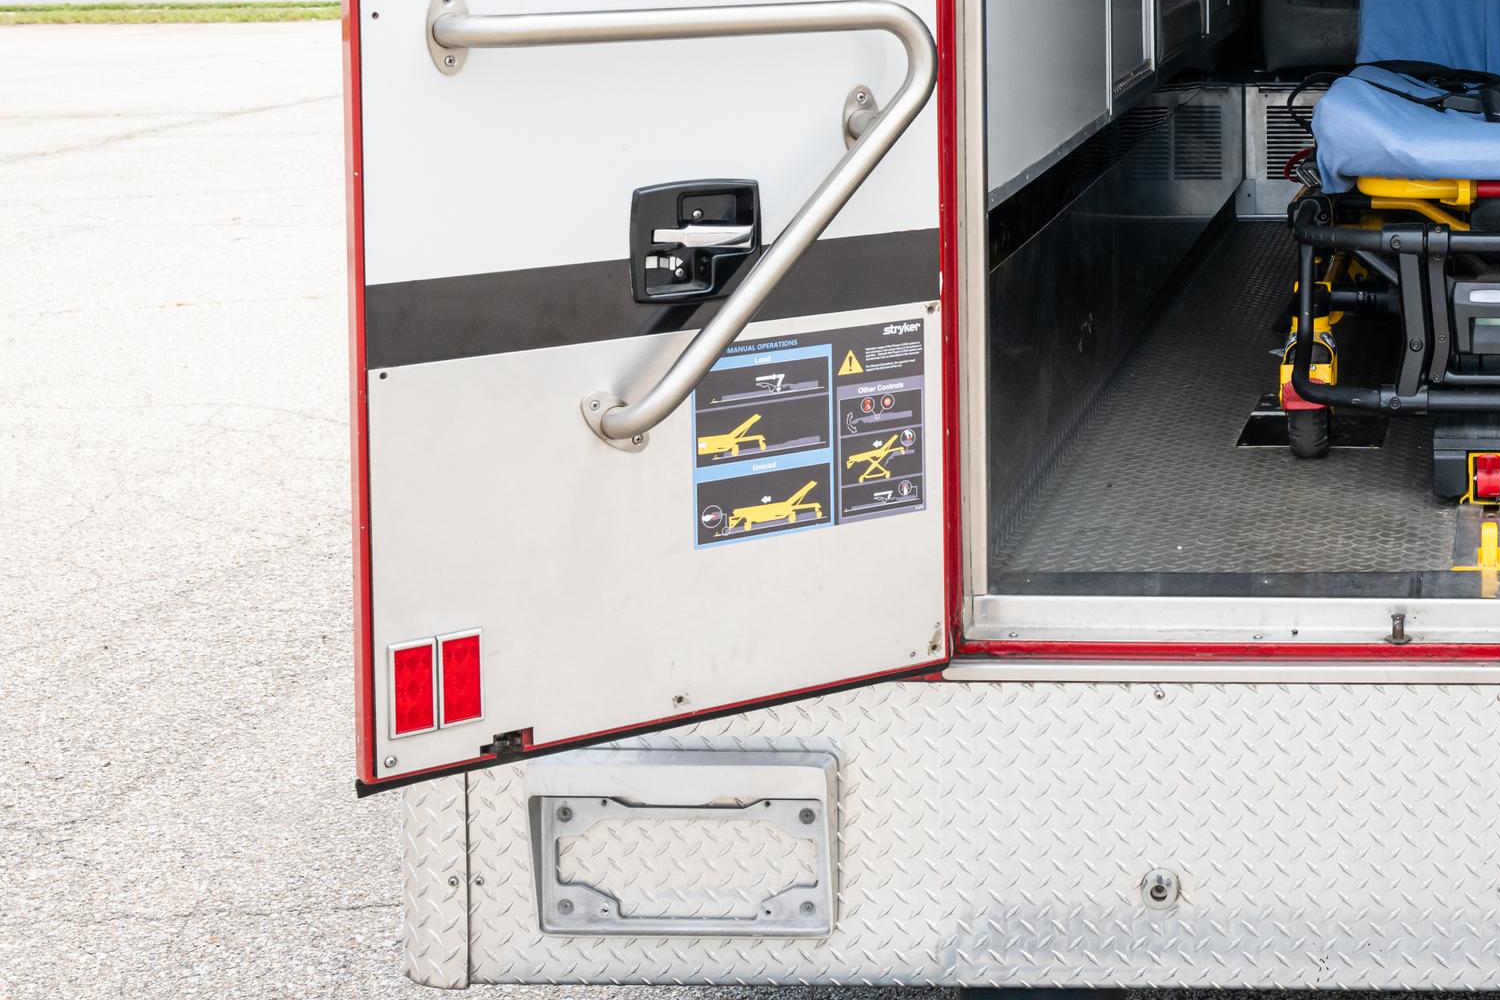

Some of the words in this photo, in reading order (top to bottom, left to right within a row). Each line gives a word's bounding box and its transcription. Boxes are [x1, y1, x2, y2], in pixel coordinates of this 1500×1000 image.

[883, 323, 921, 336] stryker
[727, 345, 756, 354] MANUAL
[757, 339, 798, 350] OPERATIONS
[754, 355, 772, 364] Load
[858, 385, 876, 394] Other
[877, 382, 904, 391] Controls
[752, 461, 776, 472] Unload
